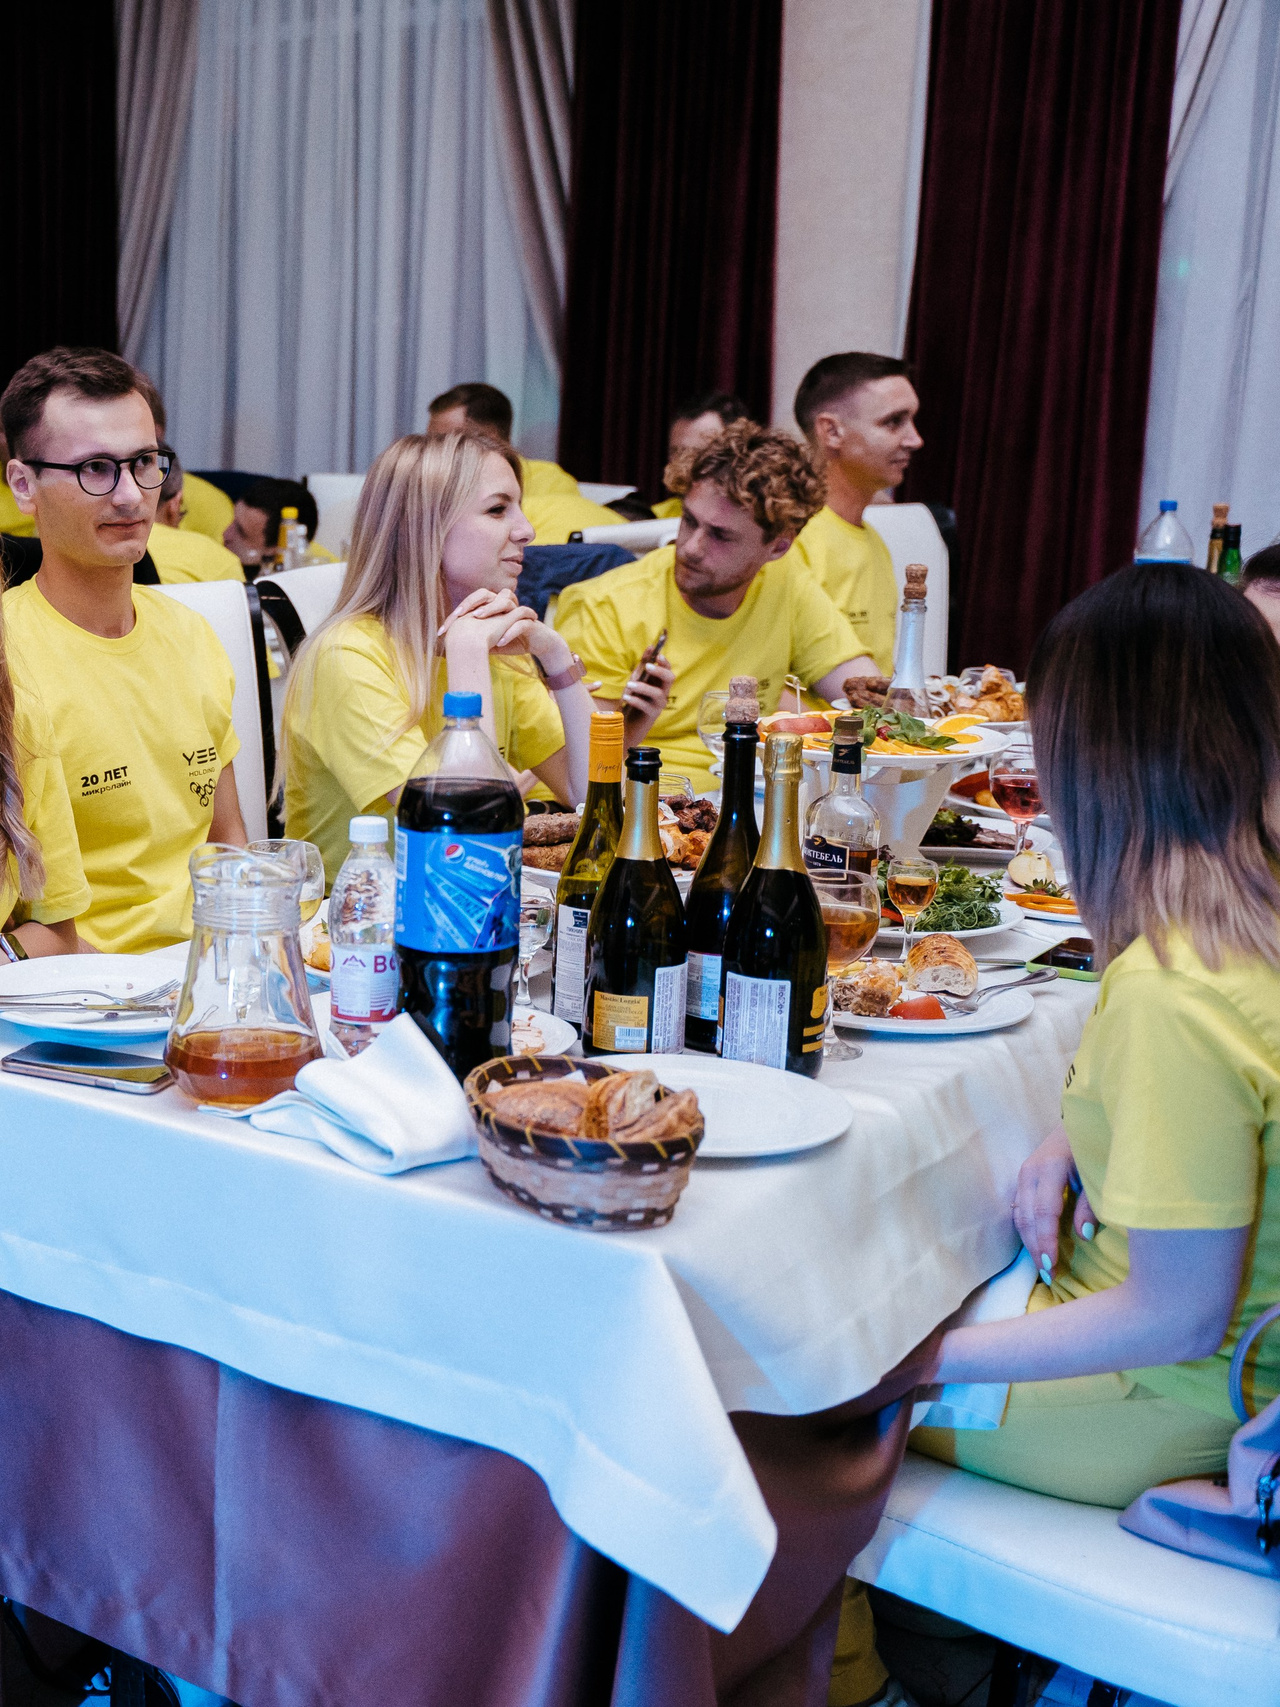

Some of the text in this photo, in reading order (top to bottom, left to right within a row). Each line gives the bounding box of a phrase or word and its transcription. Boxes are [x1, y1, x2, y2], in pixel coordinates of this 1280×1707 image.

[182, 747, 217, 766] YES
[81, 766, 129, 788] 20 ЛЕТ
